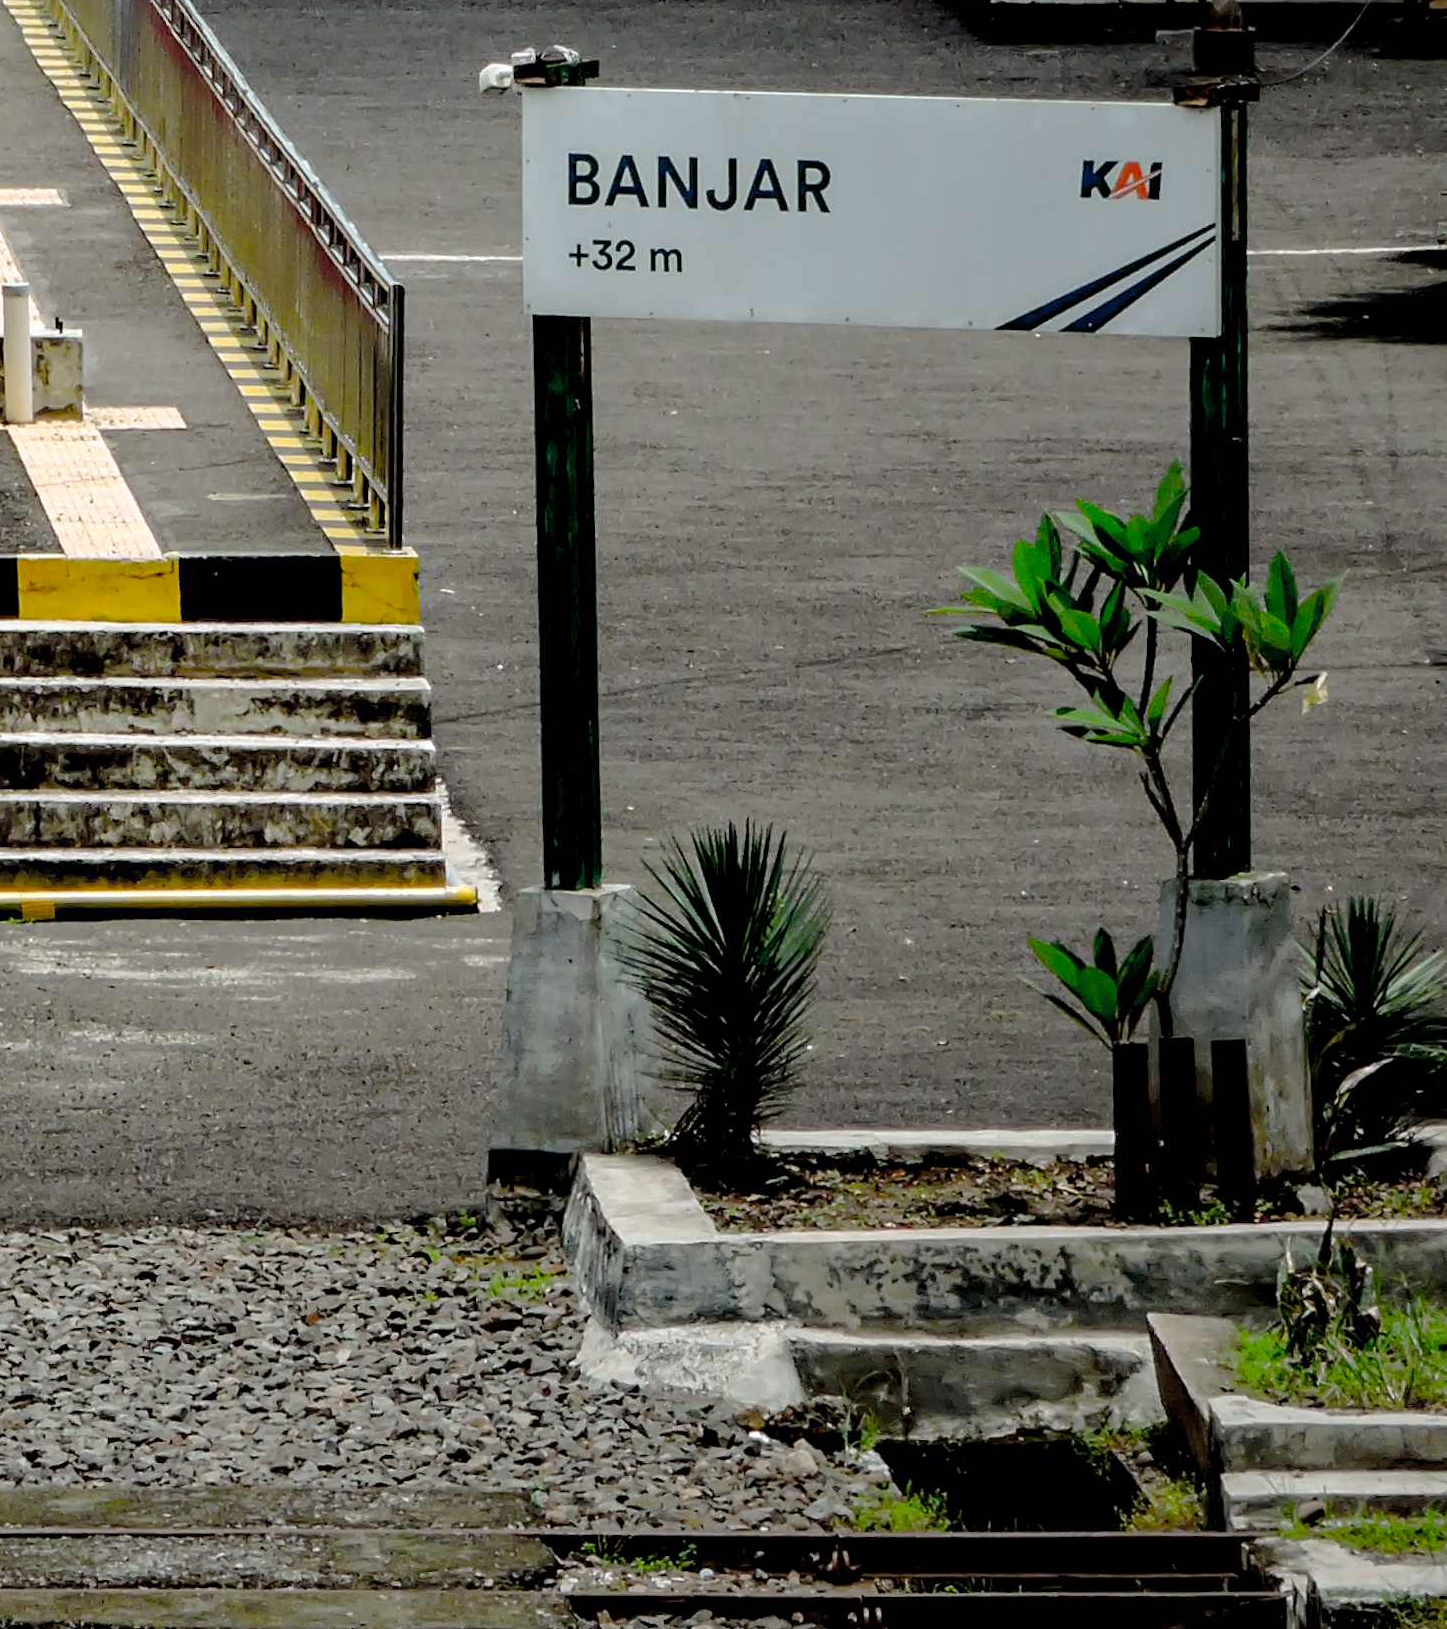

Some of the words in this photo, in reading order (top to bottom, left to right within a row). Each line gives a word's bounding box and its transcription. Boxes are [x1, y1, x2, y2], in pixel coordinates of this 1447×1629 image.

[568, 152, 831, 214] BANJAR
[1080, 159, 1163, 201] KAI
[568, 239, 636, 272] +32
[649, 248, 683, 273] m
